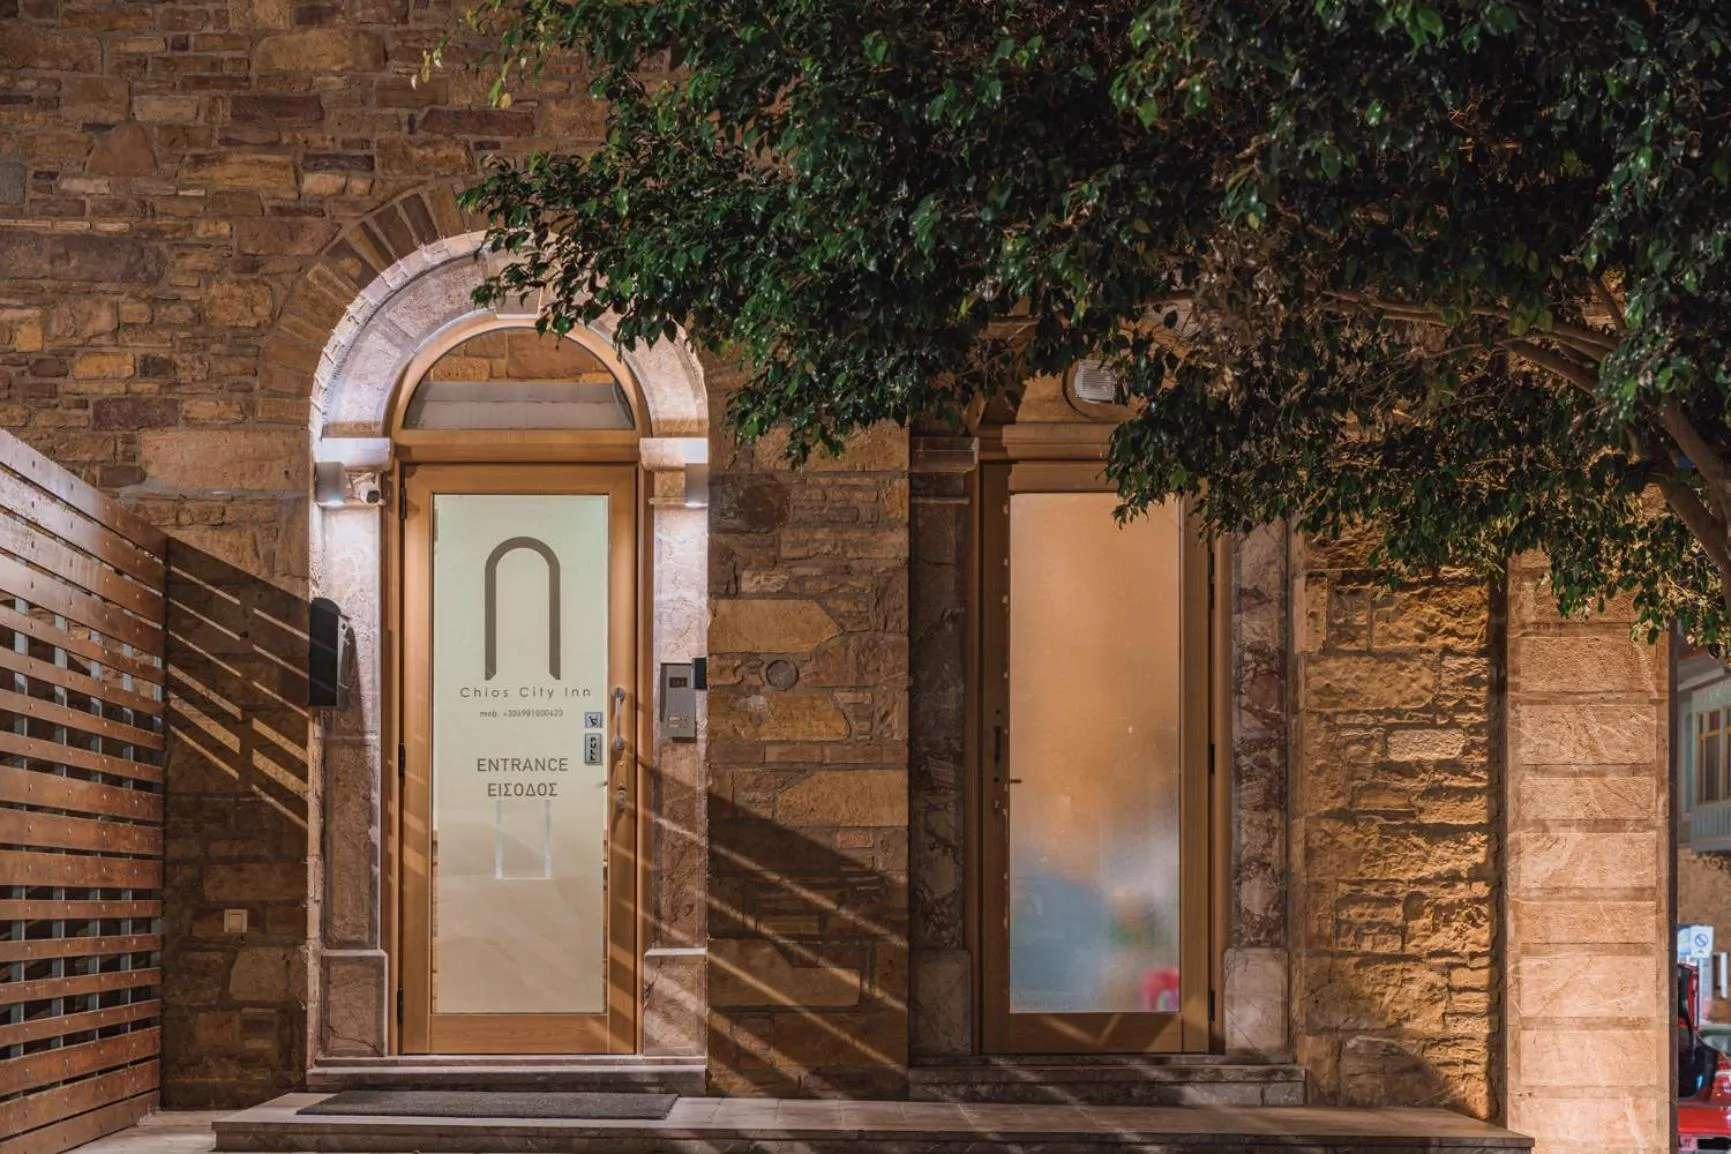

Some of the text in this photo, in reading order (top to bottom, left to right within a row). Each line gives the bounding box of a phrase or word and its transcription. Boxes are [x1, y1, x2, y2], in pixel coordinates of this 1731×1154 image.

[459, 686, 592, 699] Chios City Inn
[476, 758, 569, 772] ENTRANCE
[487, 782, 559, 797] ΕΙΣΟΔΟΣ
